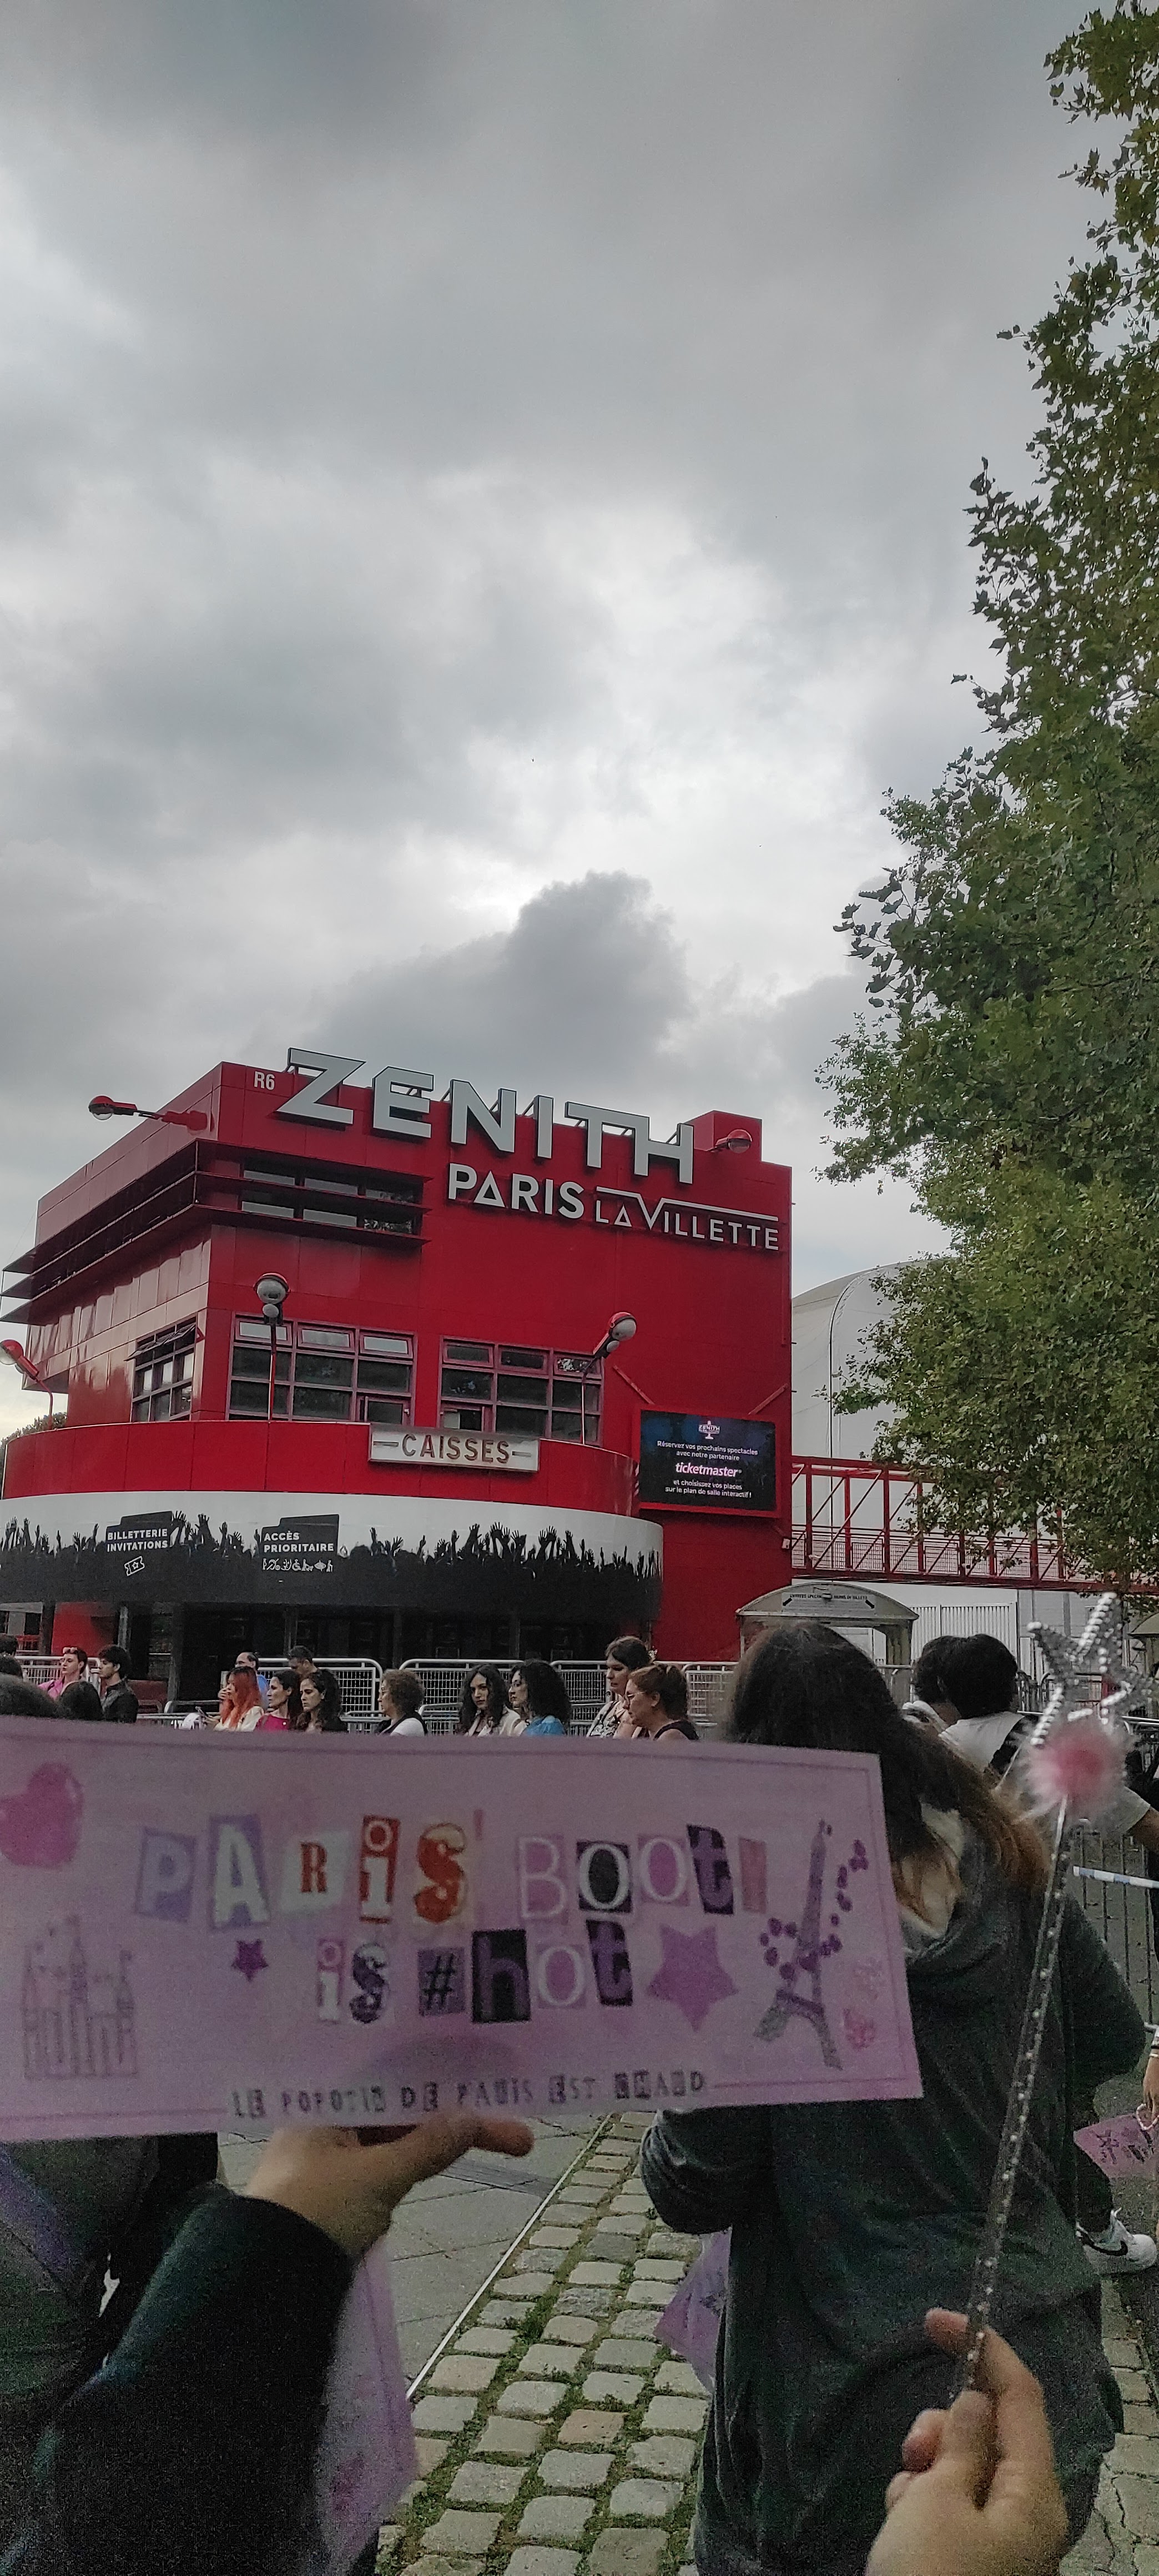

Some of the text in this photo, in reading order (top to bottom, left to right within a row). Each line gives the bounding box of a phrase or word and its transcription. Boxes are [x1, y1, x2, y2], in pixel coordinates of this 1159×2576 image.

[254, 1071, 275, 1090] R6
[276, 1048, 694, 1184] ZENITH
[449, 1163, 584, 1219] PARIS
[401, 1433, 510, 1464] CAISSES
[657, 1440, 685, 1449] Réservez
[676, 1462, 738, 1477] ticketmaster
[681, 1479, 712, 1488] choisissez
[107, 1528, 168, 1541] BILLETTERIE
[264, 1530, 300, 1541] ACCÈS
[107, 1540, 168, 1552] INVITATIONS
[264, 1543, 334, 1553] PRIORITAIRE
